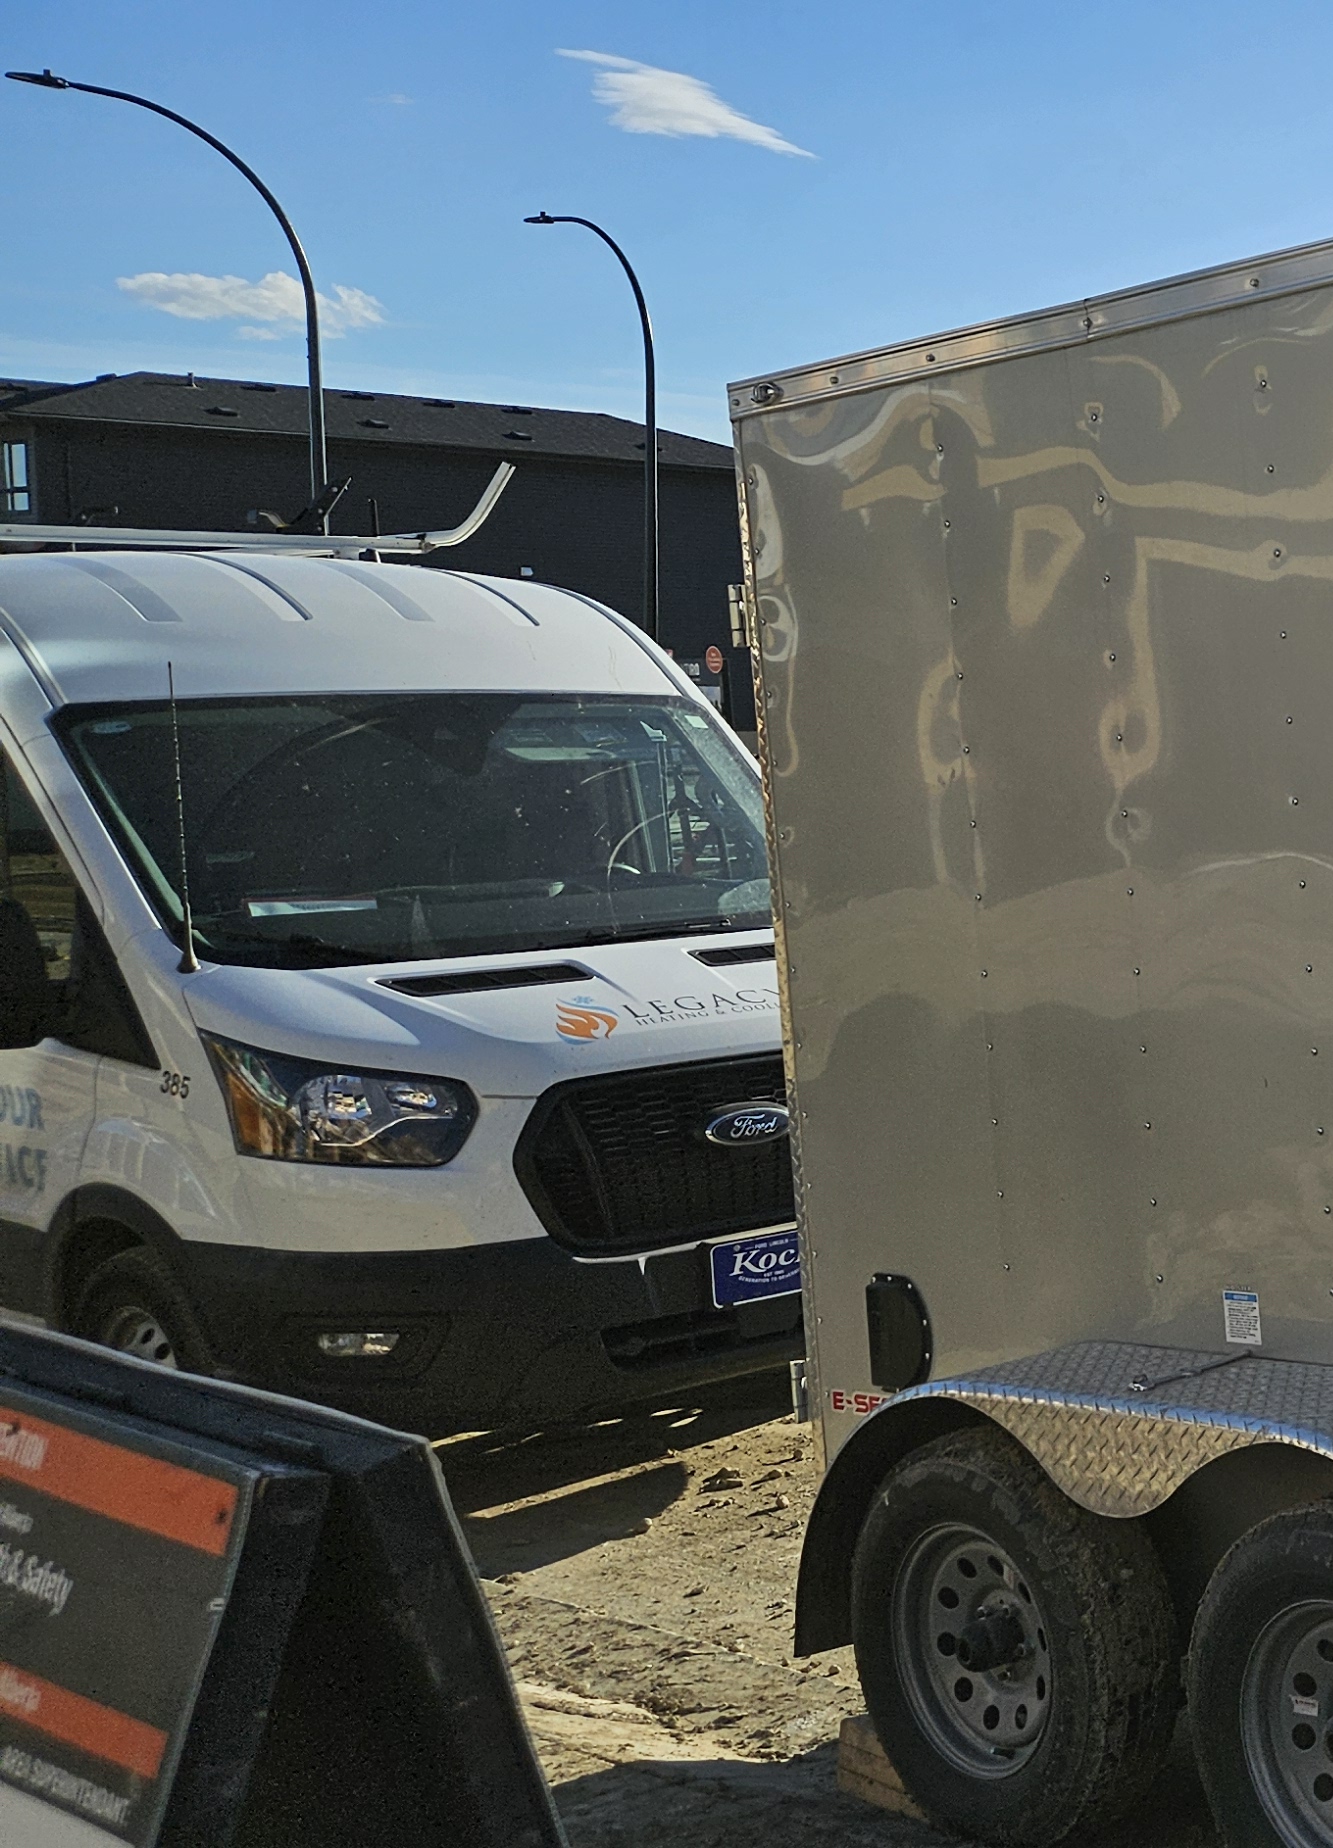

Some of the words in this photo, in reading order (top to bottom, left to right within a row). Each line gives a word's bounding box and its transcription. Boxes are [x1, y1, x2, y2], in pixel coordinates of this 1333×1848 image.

[636, 1010, 709, 1026] HEATING
[160, 1070, 191, 1099] 385
[731, 1114, 778, 1138] Ford
[832, 1391, 888, 1413] E-SE
